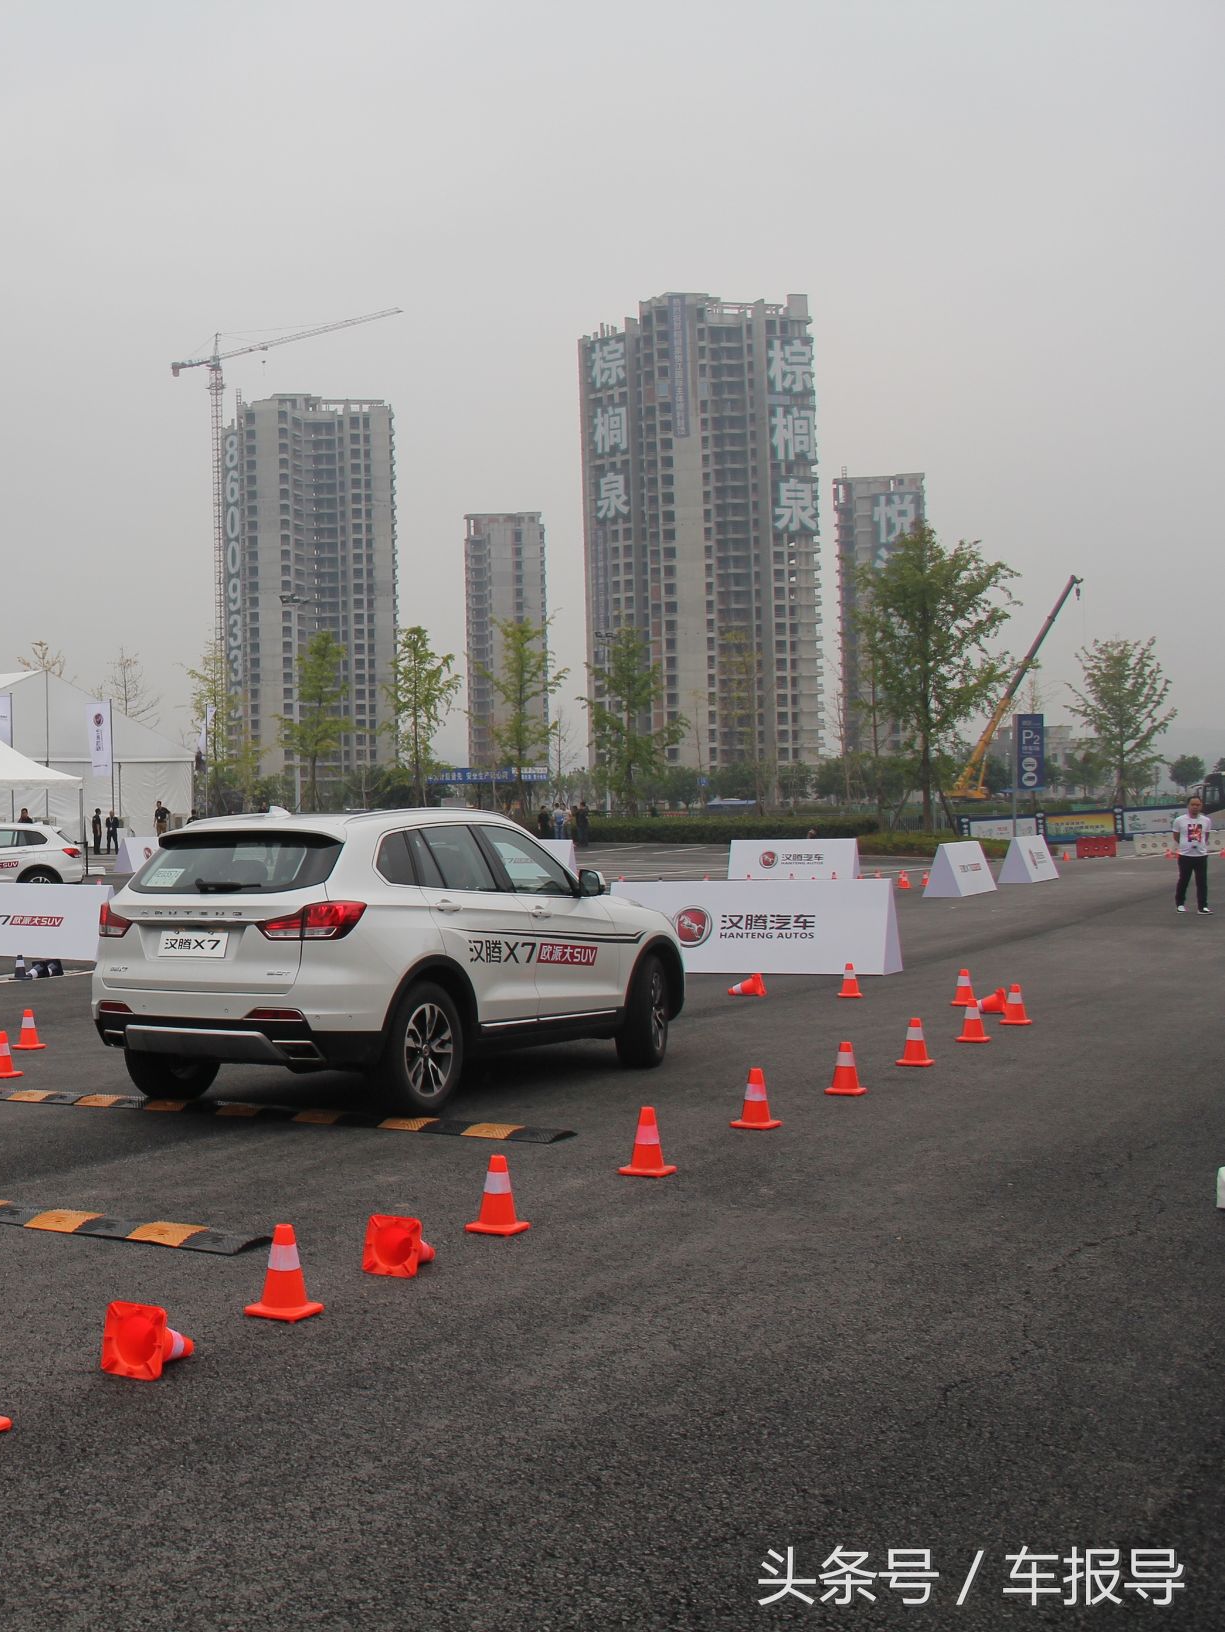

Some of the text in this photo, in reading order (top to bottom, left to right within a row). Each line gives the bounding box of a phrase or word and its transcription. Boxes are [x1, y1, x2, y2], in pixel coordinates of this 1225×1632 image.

[591, 338, 629, 519] 棕榈泉
[767, 339, 817, 532] 棕榈泉
[1022, 729, 1040, 745] P2
[720, 914, 816, 930] 汉腾汽车
[164, 938, 221, 950] 汉腾X7
[468, 939, 597, 963] 汉腾X7 欧派大SUV
